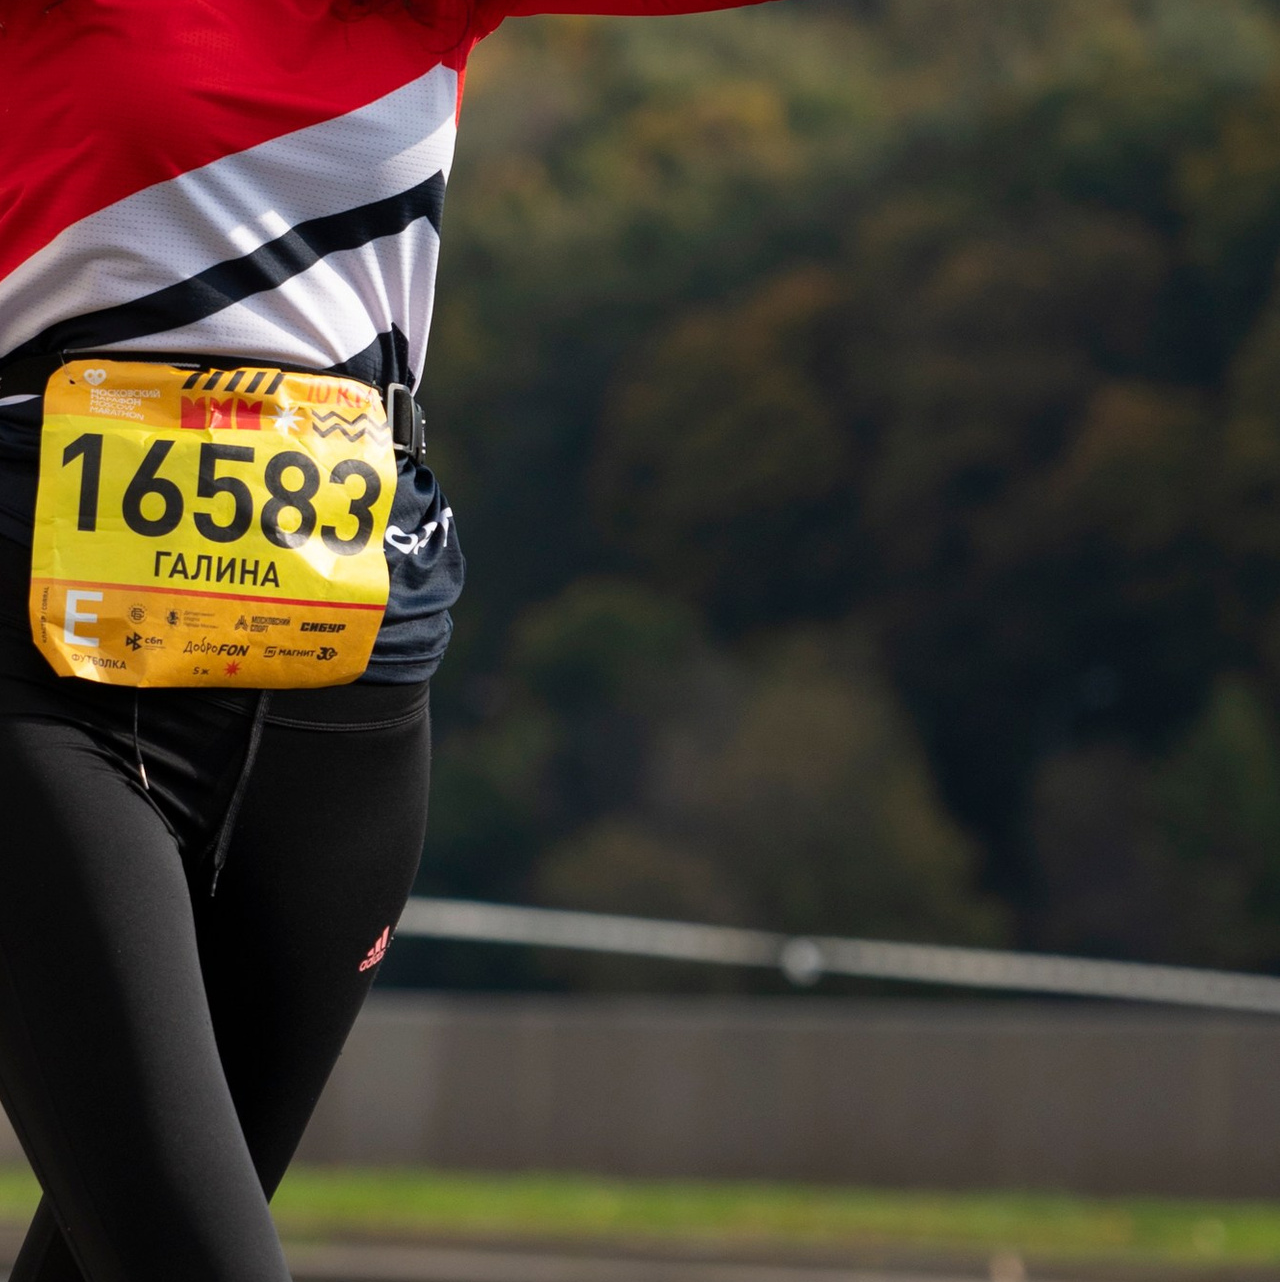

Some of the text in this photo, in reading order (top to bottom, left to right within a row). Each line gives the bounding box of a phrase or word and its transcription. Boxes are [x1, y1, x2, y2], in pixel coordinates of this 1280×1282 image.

[90, 388, 161, 398] МОСКОВСКИЙ
[89, 406, 145, 421] MARATHON
[61, 432, 382, 556] 16583
[154, 551, 281, 588] ГАЛИНА
[300, 622, 346, 633] СИБУР
[278, 648, 317, 657] МАГНИТ
[71, 653, 127, 670] ФУТБОЛКА
